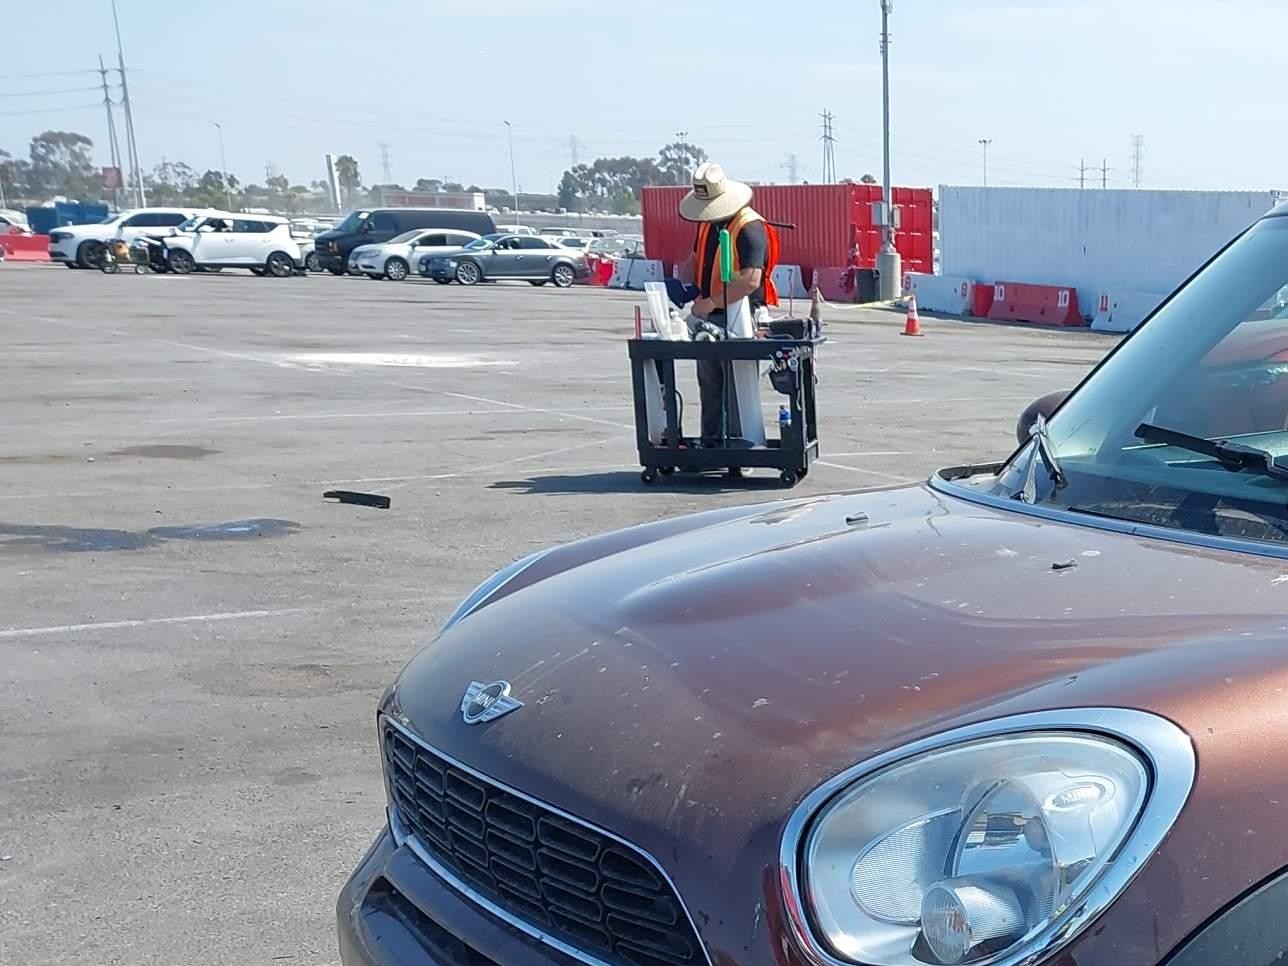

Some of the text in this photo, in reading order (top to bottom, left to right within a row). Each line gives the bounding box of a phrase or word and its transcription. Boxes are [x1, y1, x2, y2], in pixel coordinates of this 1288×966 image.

[960, 282, 968, 297] 9
[994, 284, 1005, 302] 10
[1057, 289, 1070, 307] 10
[1099, 294, 1109, 312] 11
